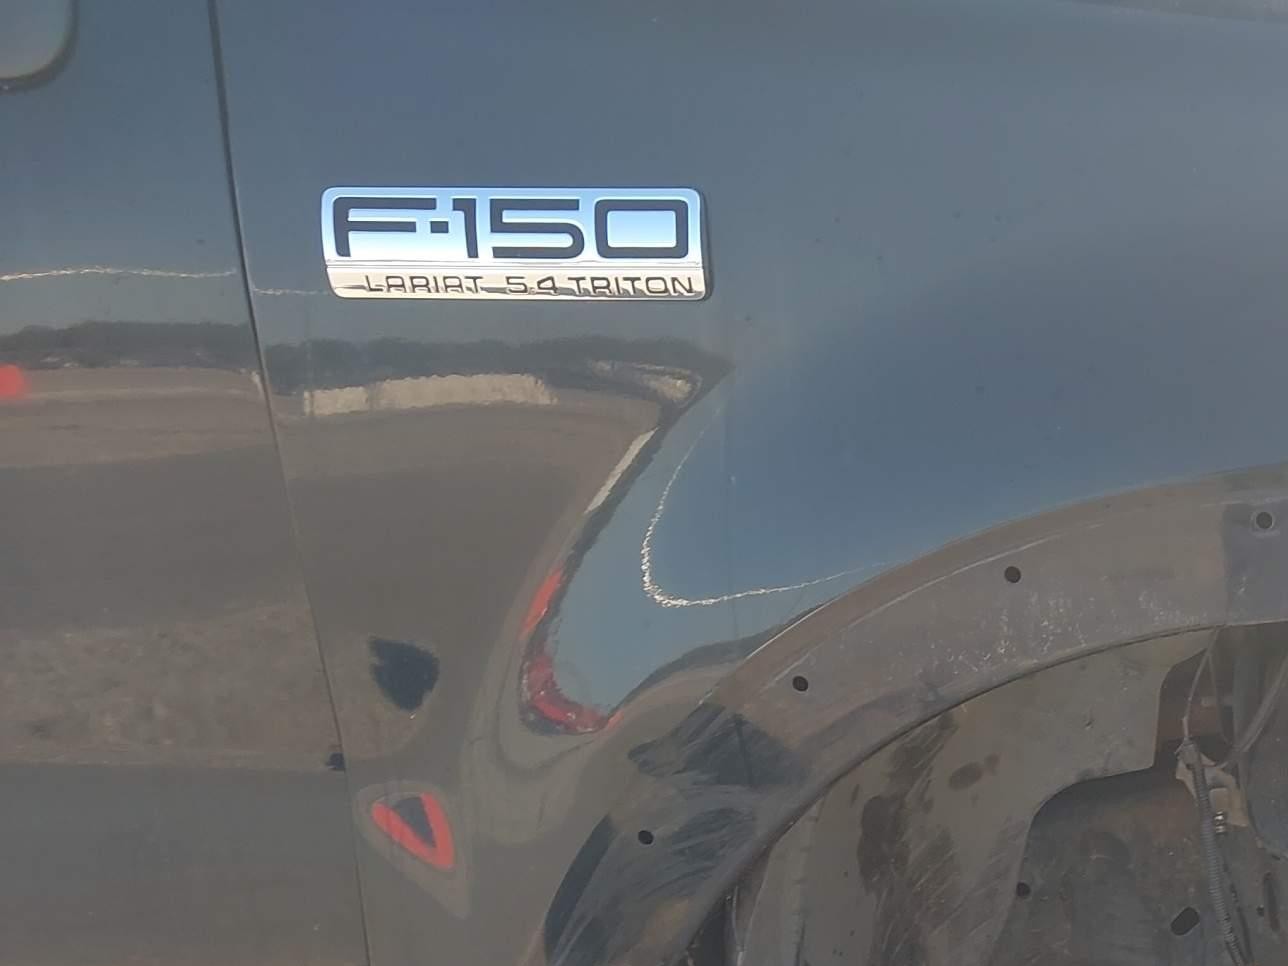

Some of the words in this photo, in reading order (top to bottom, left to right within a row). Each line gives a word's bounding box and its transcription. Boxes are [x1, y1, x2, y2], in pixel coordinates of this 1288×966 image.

[332, 196, 690, 259] F-150
[365, 274, 484, 294] LARIAT
[568, 276, 695, 296] TRITON
